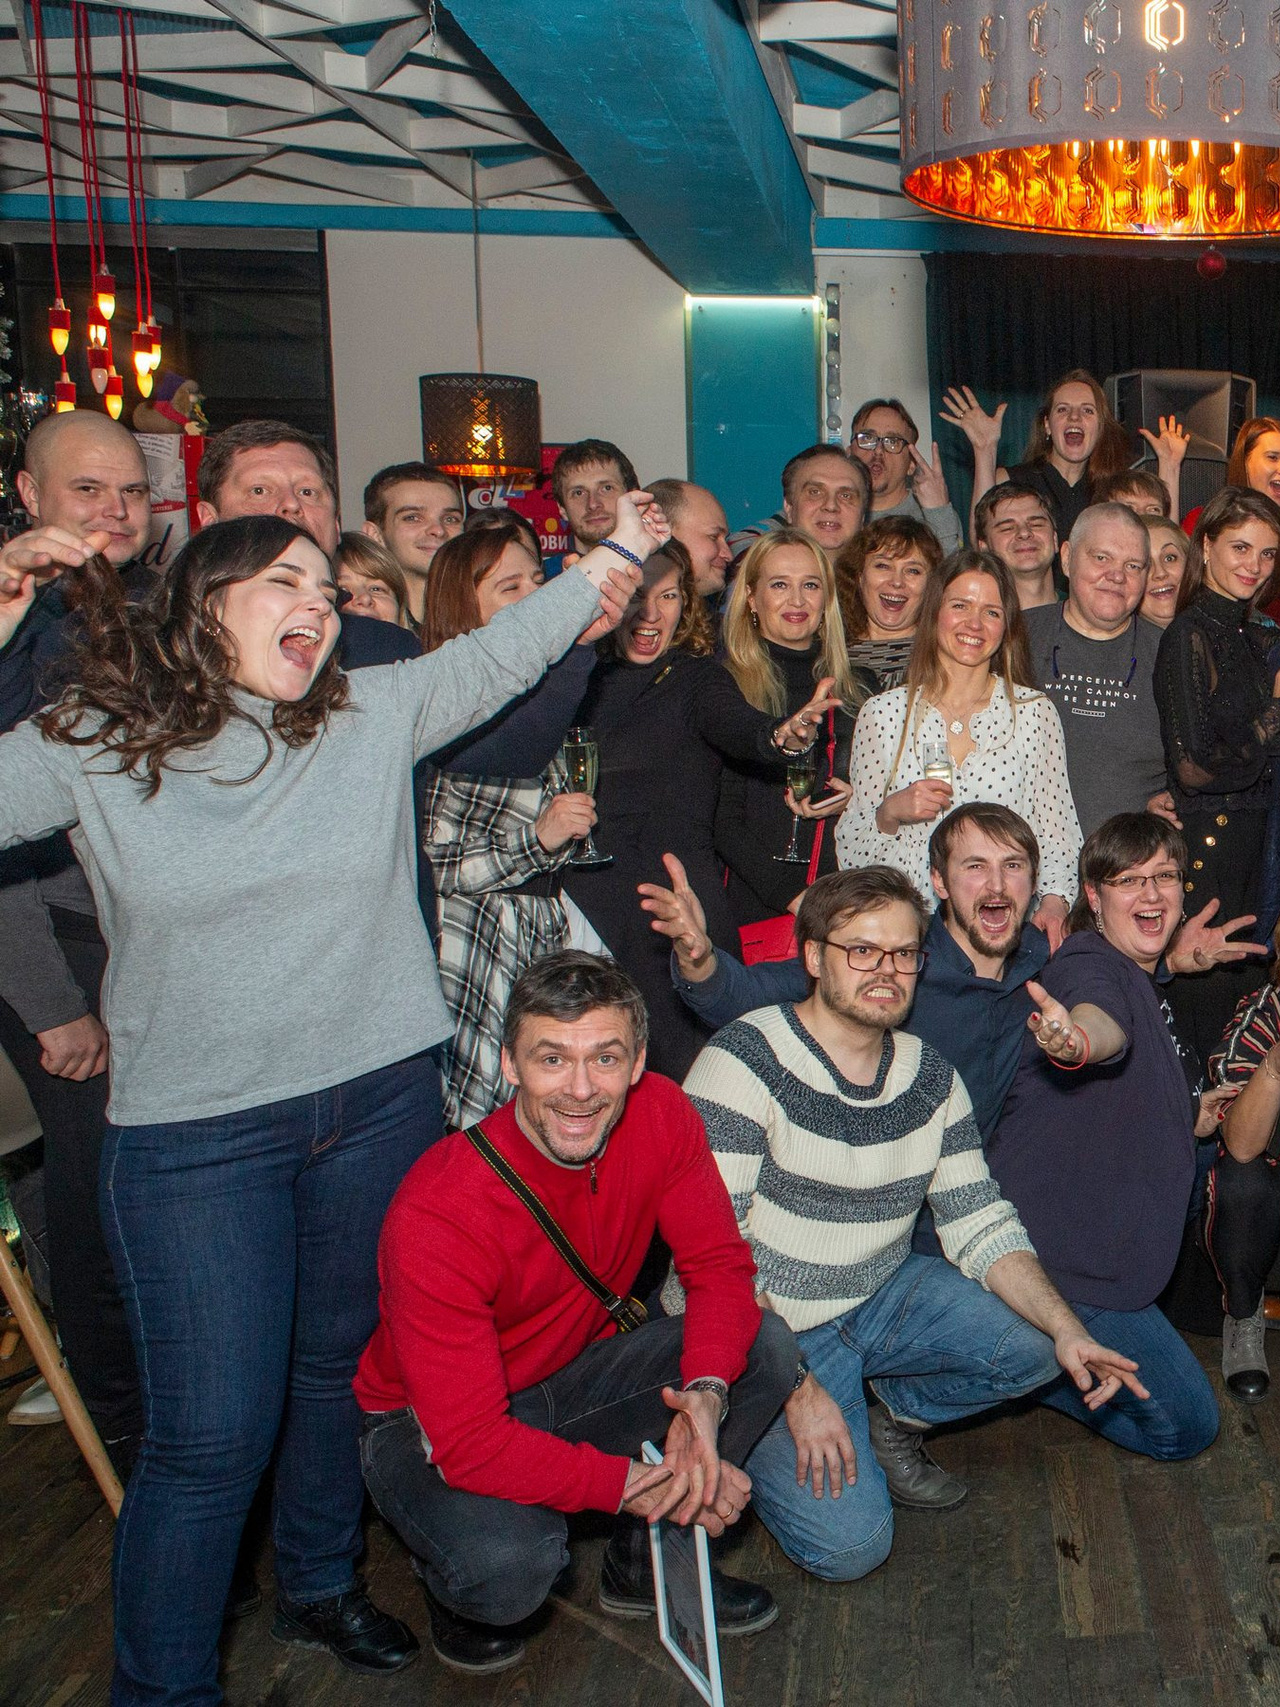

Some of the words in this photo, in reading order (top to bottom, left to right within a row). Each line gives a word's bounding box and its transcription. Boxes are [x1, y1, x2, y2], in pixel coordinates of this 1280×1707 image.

[1061, 674, 1123, 687] PERCEIVE
[1044, 683, 1078, 692] WHAT
[1086, 688, 1137, 700] CANNOT
[1064, 694, 1078, 703] BE
[1086, 699, 1116, 707] SEEN
